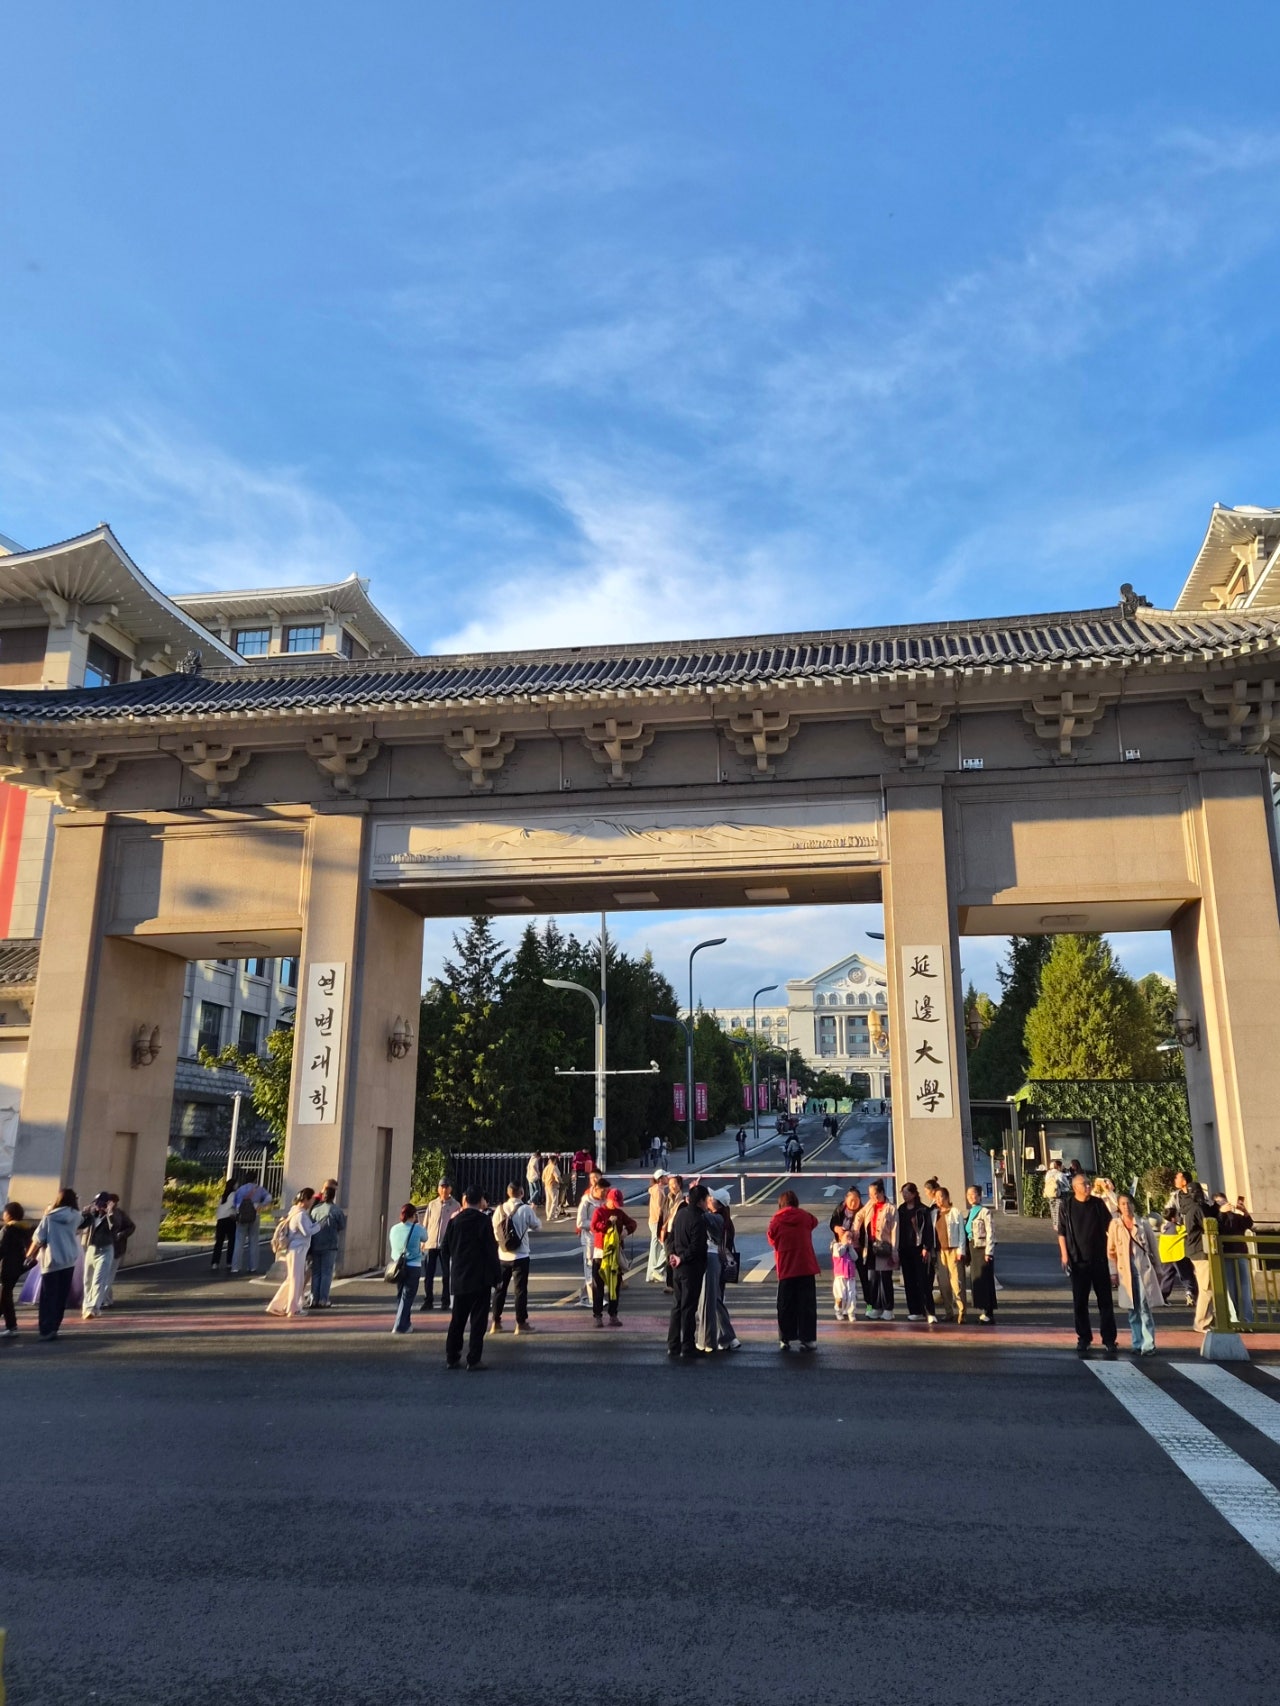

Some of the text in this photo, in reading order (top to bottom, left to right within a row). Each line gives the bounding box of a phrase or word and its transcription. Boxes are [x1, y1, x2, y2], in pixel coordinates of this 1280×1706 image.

[309, 969, 336, 1121] 연변대학
[909, 954, 945, 1113] 延邊大學
